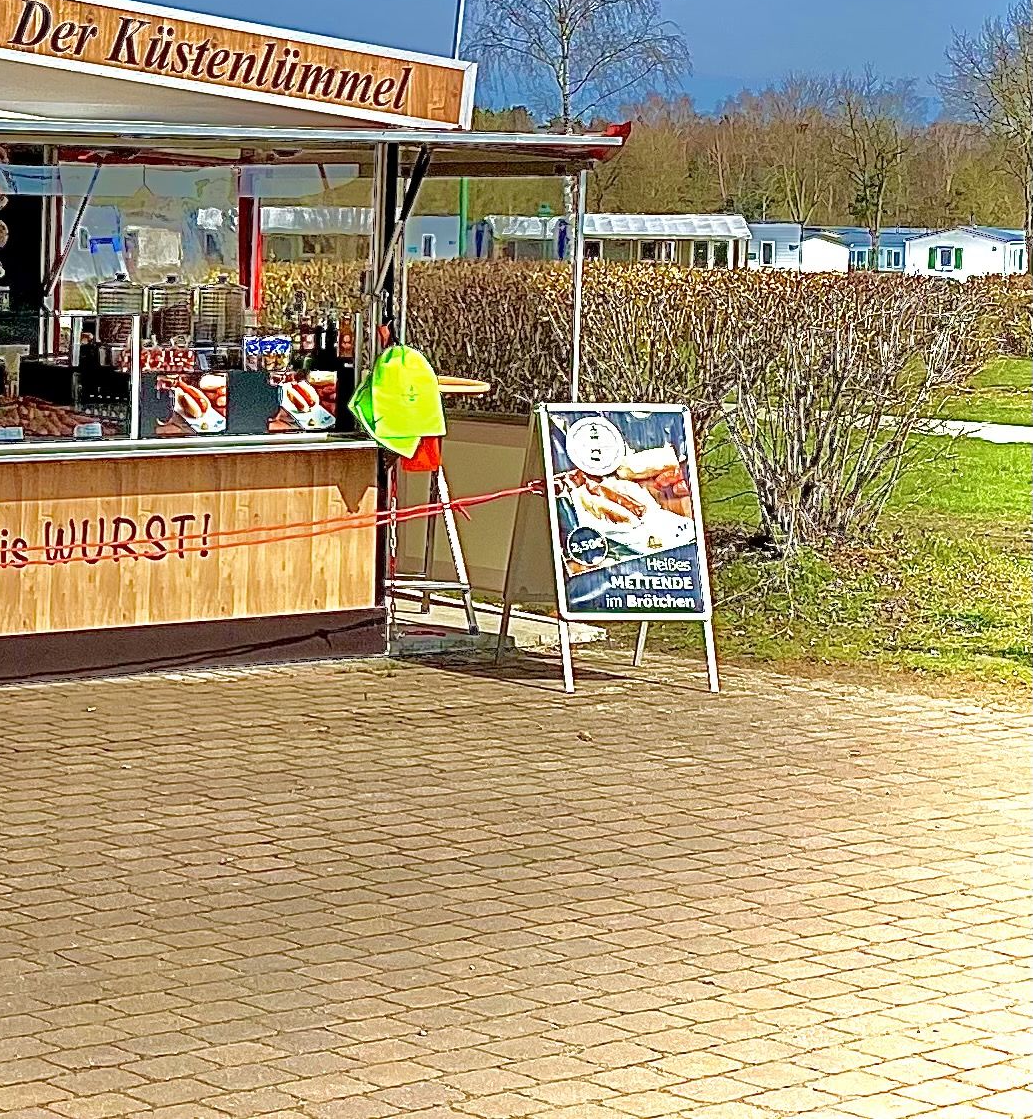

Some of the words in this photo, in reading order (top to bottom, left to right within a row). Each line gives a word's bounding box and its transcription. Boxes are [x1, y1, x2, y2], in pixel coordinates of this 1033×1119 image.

[105, 15, 413, 111] Küstenlümmel
[0, 529, 30, 569] is
[44, 513, 212, 565] WURST!
[646, 557, 691, 572] Heißes
[610, 575, 694, 590] METTENDE
[605, 593, 623, 608] im
[626, 592, 696, 608] Brötchen
